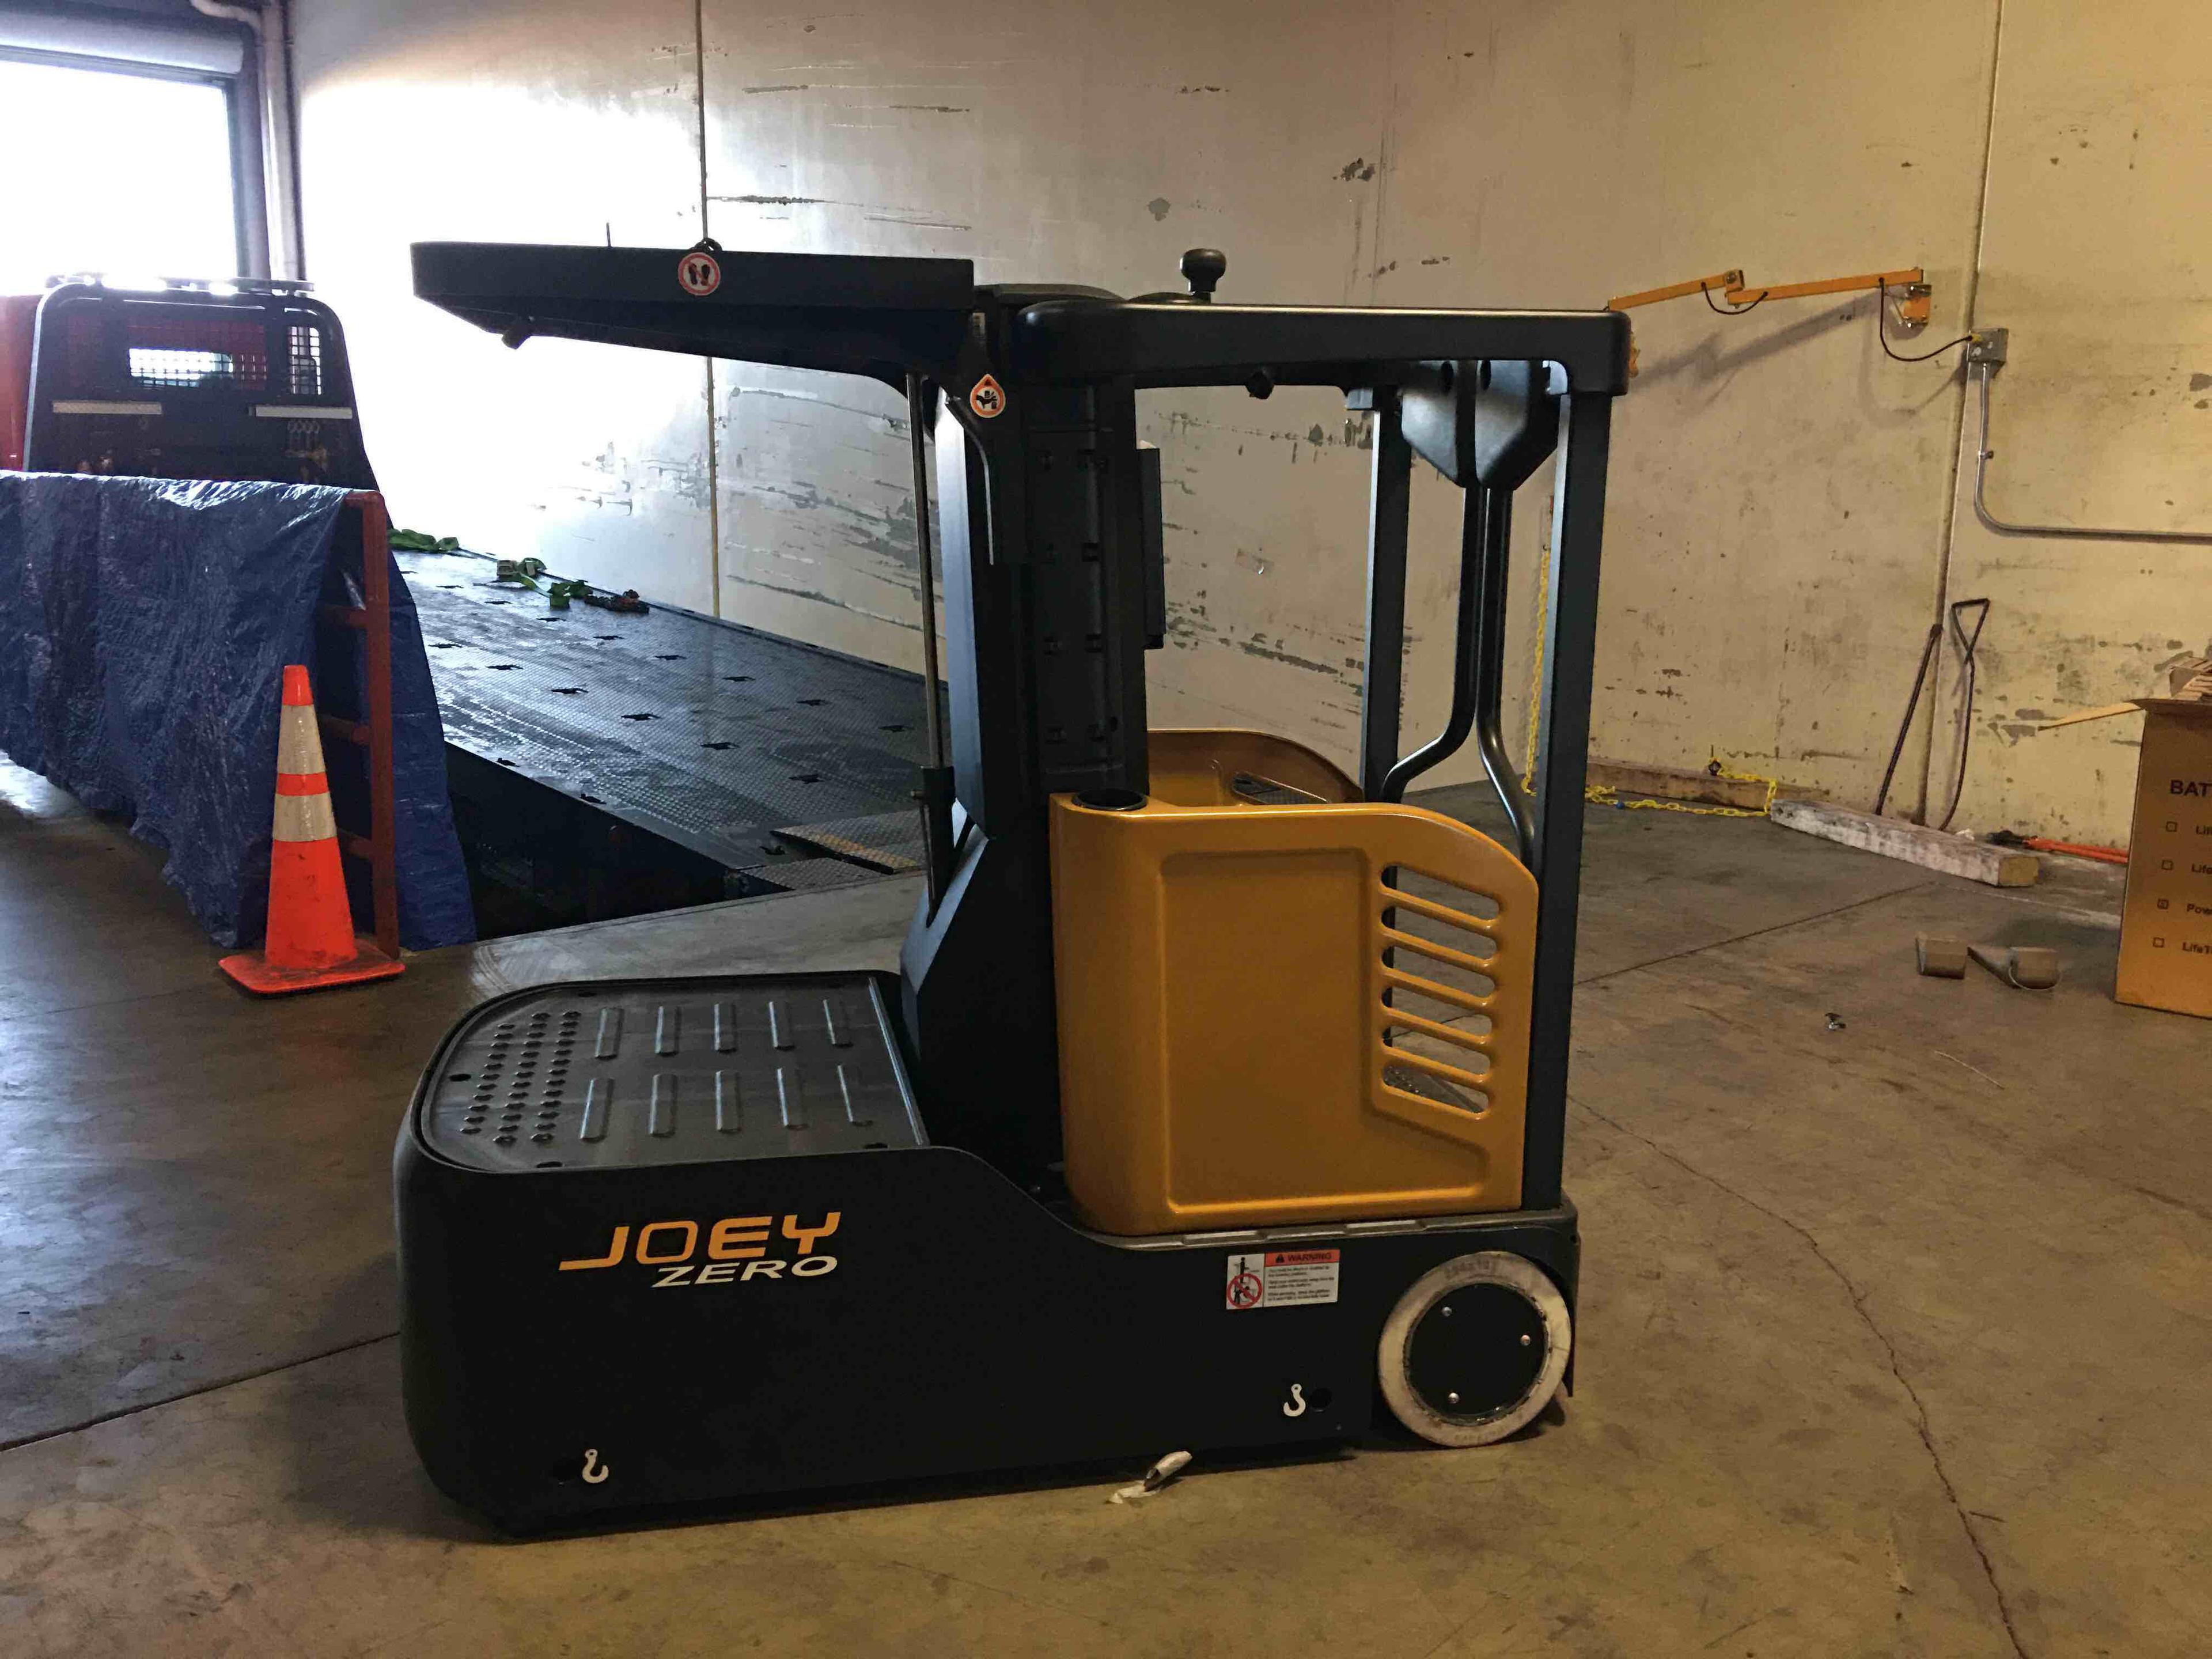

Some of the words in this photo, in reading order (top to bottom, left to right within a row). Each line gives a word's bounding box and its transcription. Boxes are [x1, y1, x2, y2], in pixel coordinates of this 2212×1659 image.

[559, 1211, 841, 1271] JOEY
[1287, 1252, 1332, 1262] WARNING
[651, 1256, 838, 1288] ZERO
